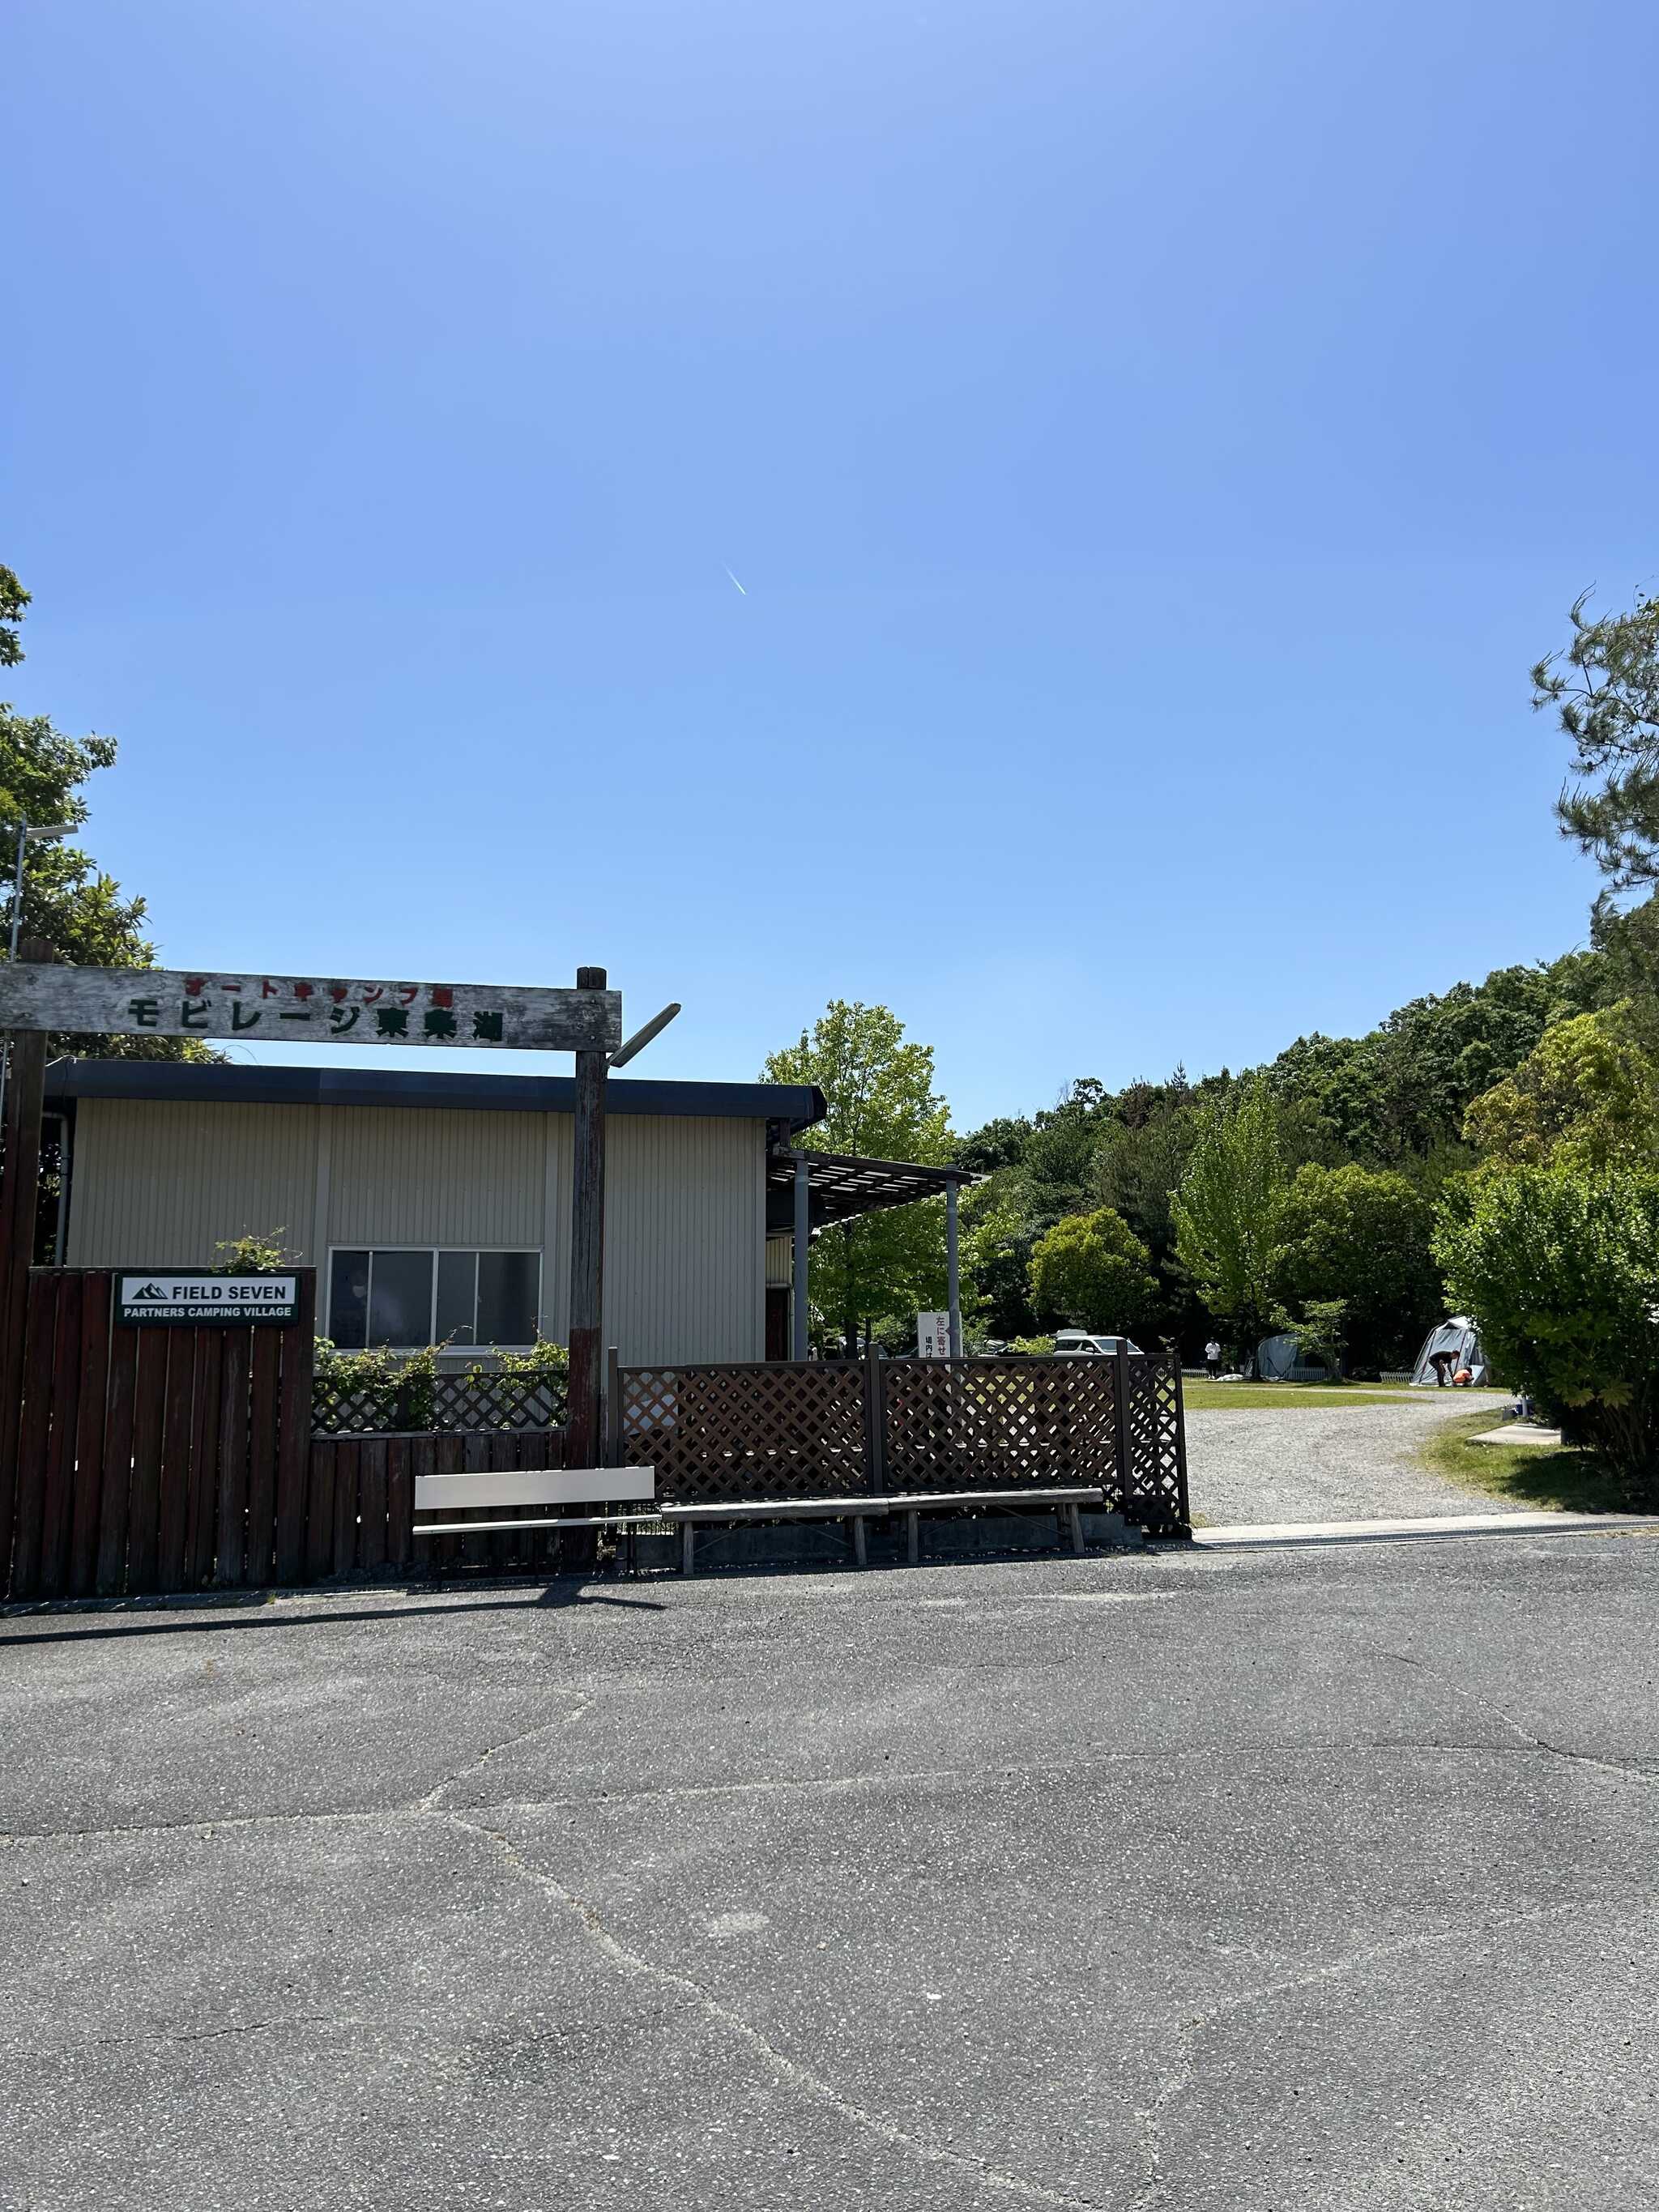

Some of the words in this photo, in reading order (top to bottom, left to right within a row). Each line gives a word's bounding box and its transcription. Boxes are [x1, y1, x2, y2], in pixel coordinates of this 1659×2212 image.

[173, 1286, 222, 1299] FIELD
[228, 1286, 286, 1299] SEVEN
[124, 1307, 185, 1318] PARTNERS
[188, 1307, 241, 1317] CAMPING
[243, 1306, 292, 1317] VILLAGE
